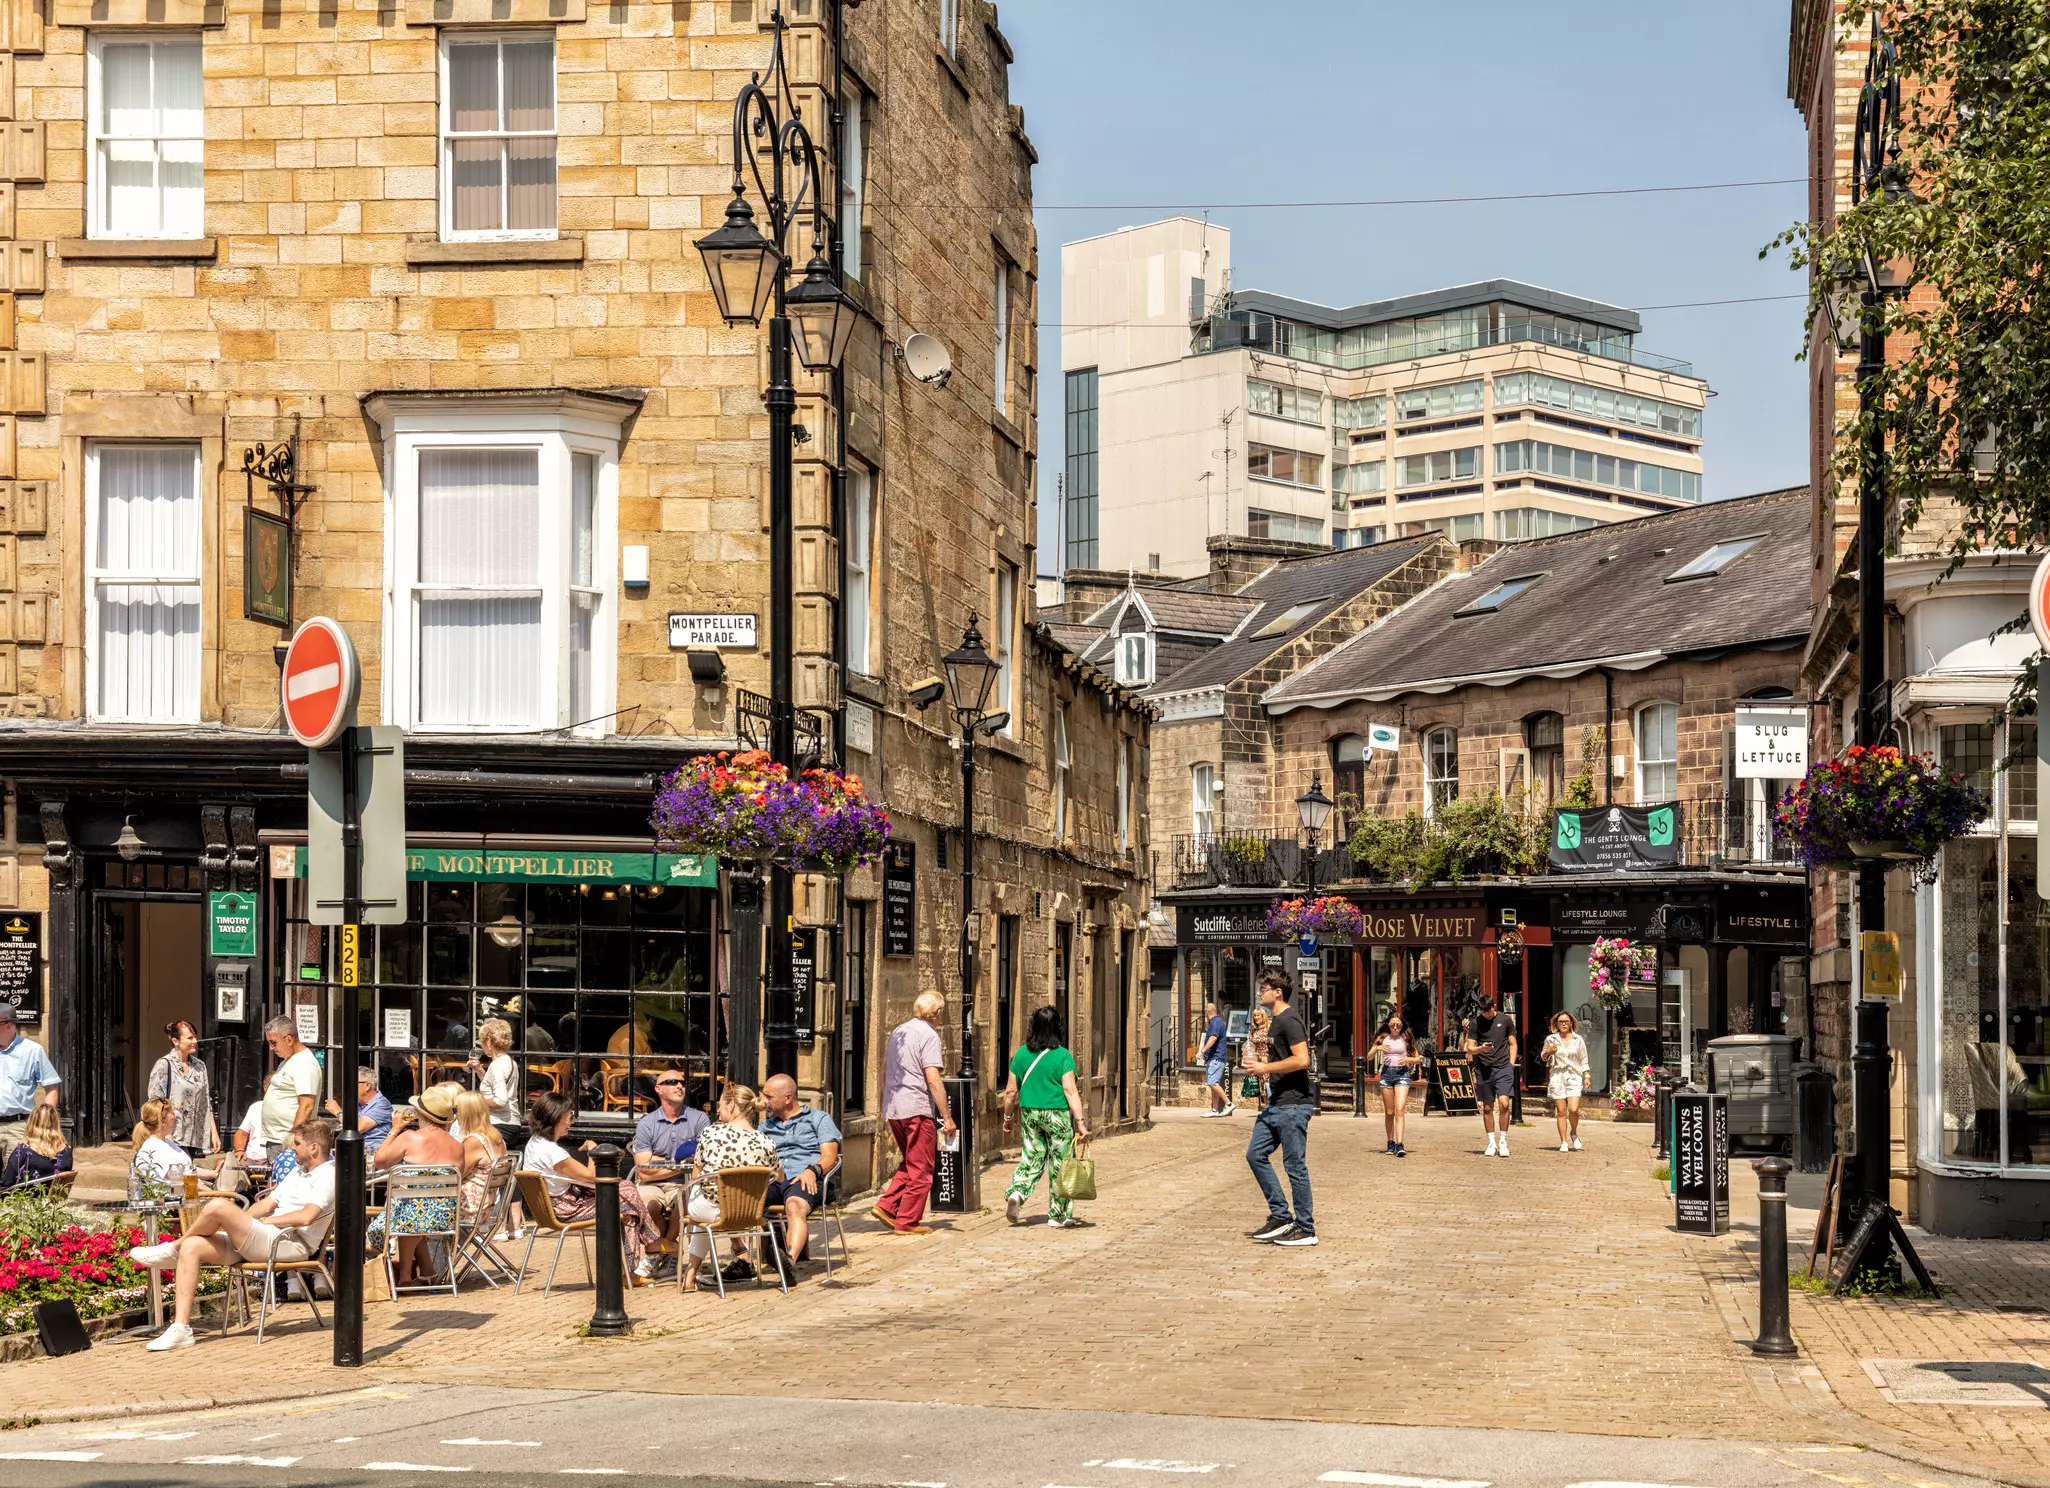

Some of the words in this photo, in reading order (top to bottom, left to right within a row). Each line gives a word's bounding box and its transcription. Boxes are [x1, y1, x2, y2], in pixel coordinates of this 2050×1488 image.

[672, 618, 752, 630] MONTPELLIER
[1755, 726, 1788, 736] SLUG
[1769, 739, 1775, 749] &
[1742, 752, 1801, 763] LETTUCE
[438, 856, 614, 877] MONTPELLIER
[1194, 916, 1230, 931] Sutcliffe
[1361, 914, 1405, 938] ROSE
[1410, 914, 1475, 937] VELVET
[1729, 916, 1790, 928] LIFESTYLE
[1444, 1084, 1475, 1099] SALE
[1681, 1108, 1690, 1138] IN'S
[1693, 1105, 1703, 1187] WELCOME
[1682, 1141, 1691, 1186] WALK
